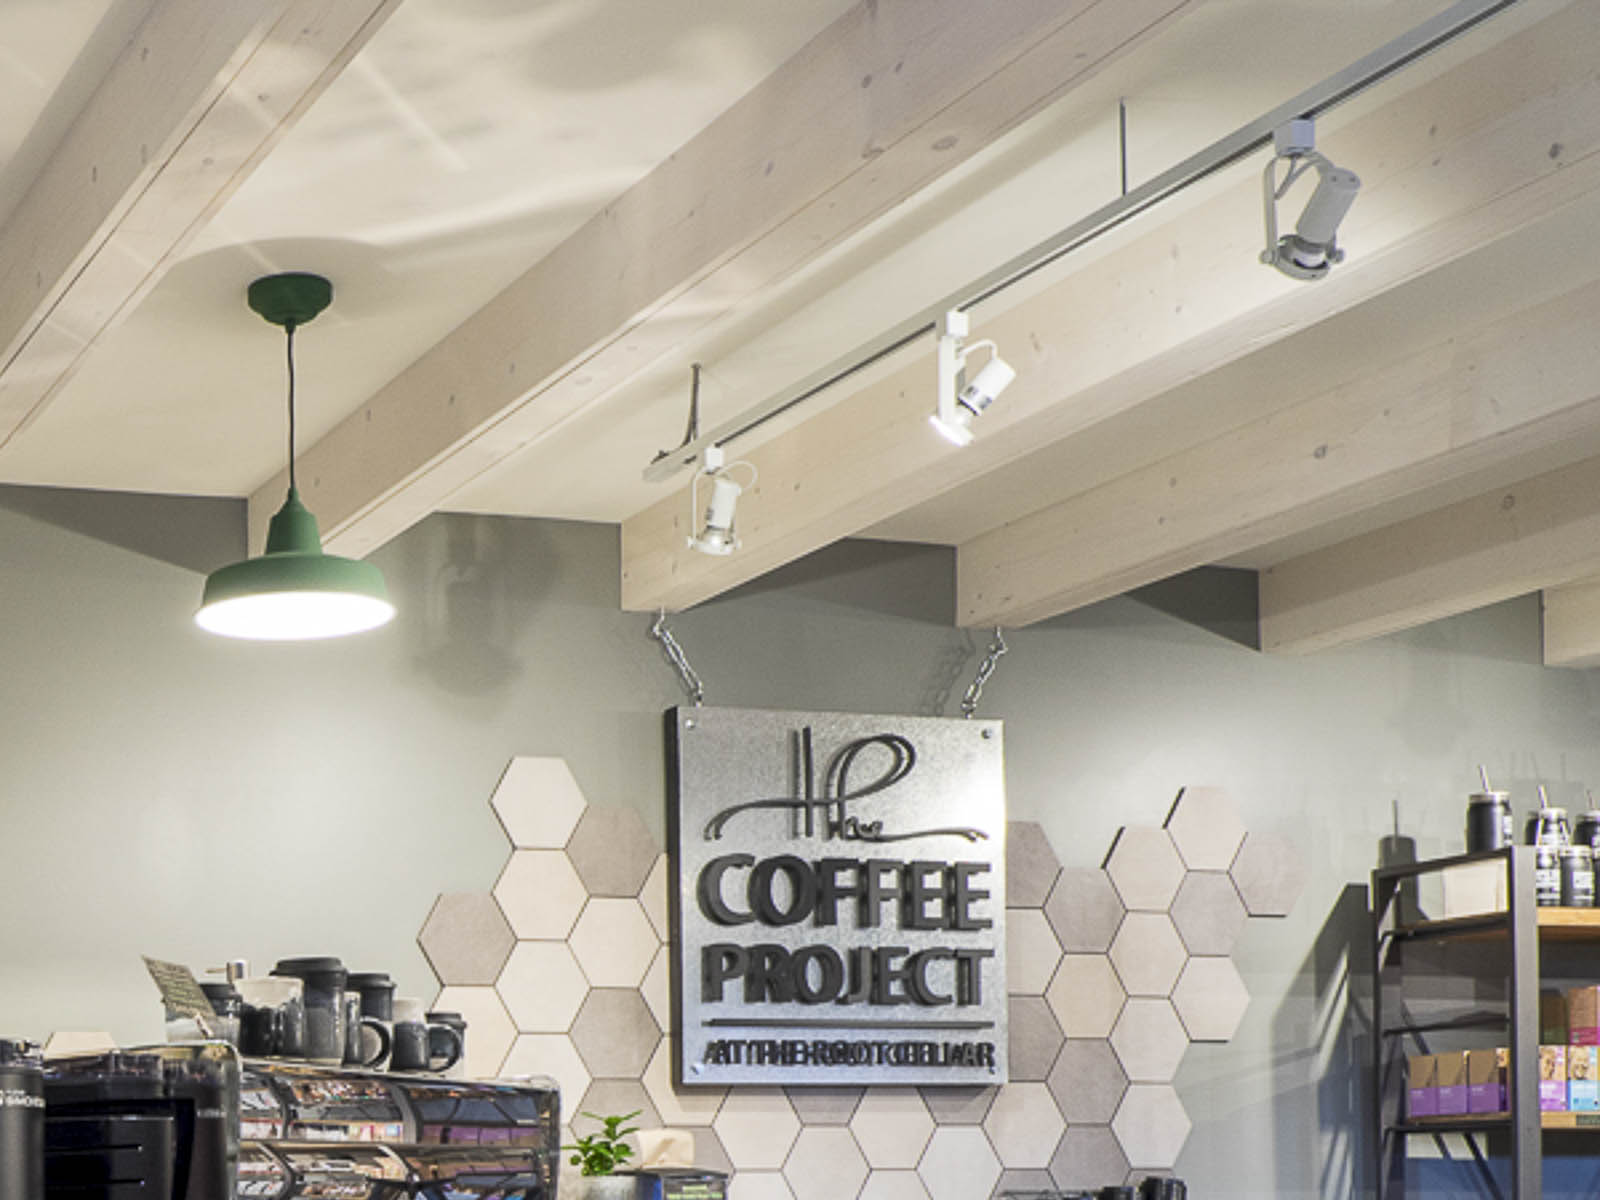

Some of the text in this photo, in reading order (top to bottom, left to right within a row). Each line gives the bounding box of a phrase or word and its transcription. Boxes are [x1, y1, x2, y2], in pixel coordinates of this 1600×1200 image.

[696, 853, 993, 930] COFFEE
[701, 943, 995, 1006] PROJECT
[703, 1040, 996, 1067] AT THE ROOT CELLAR
